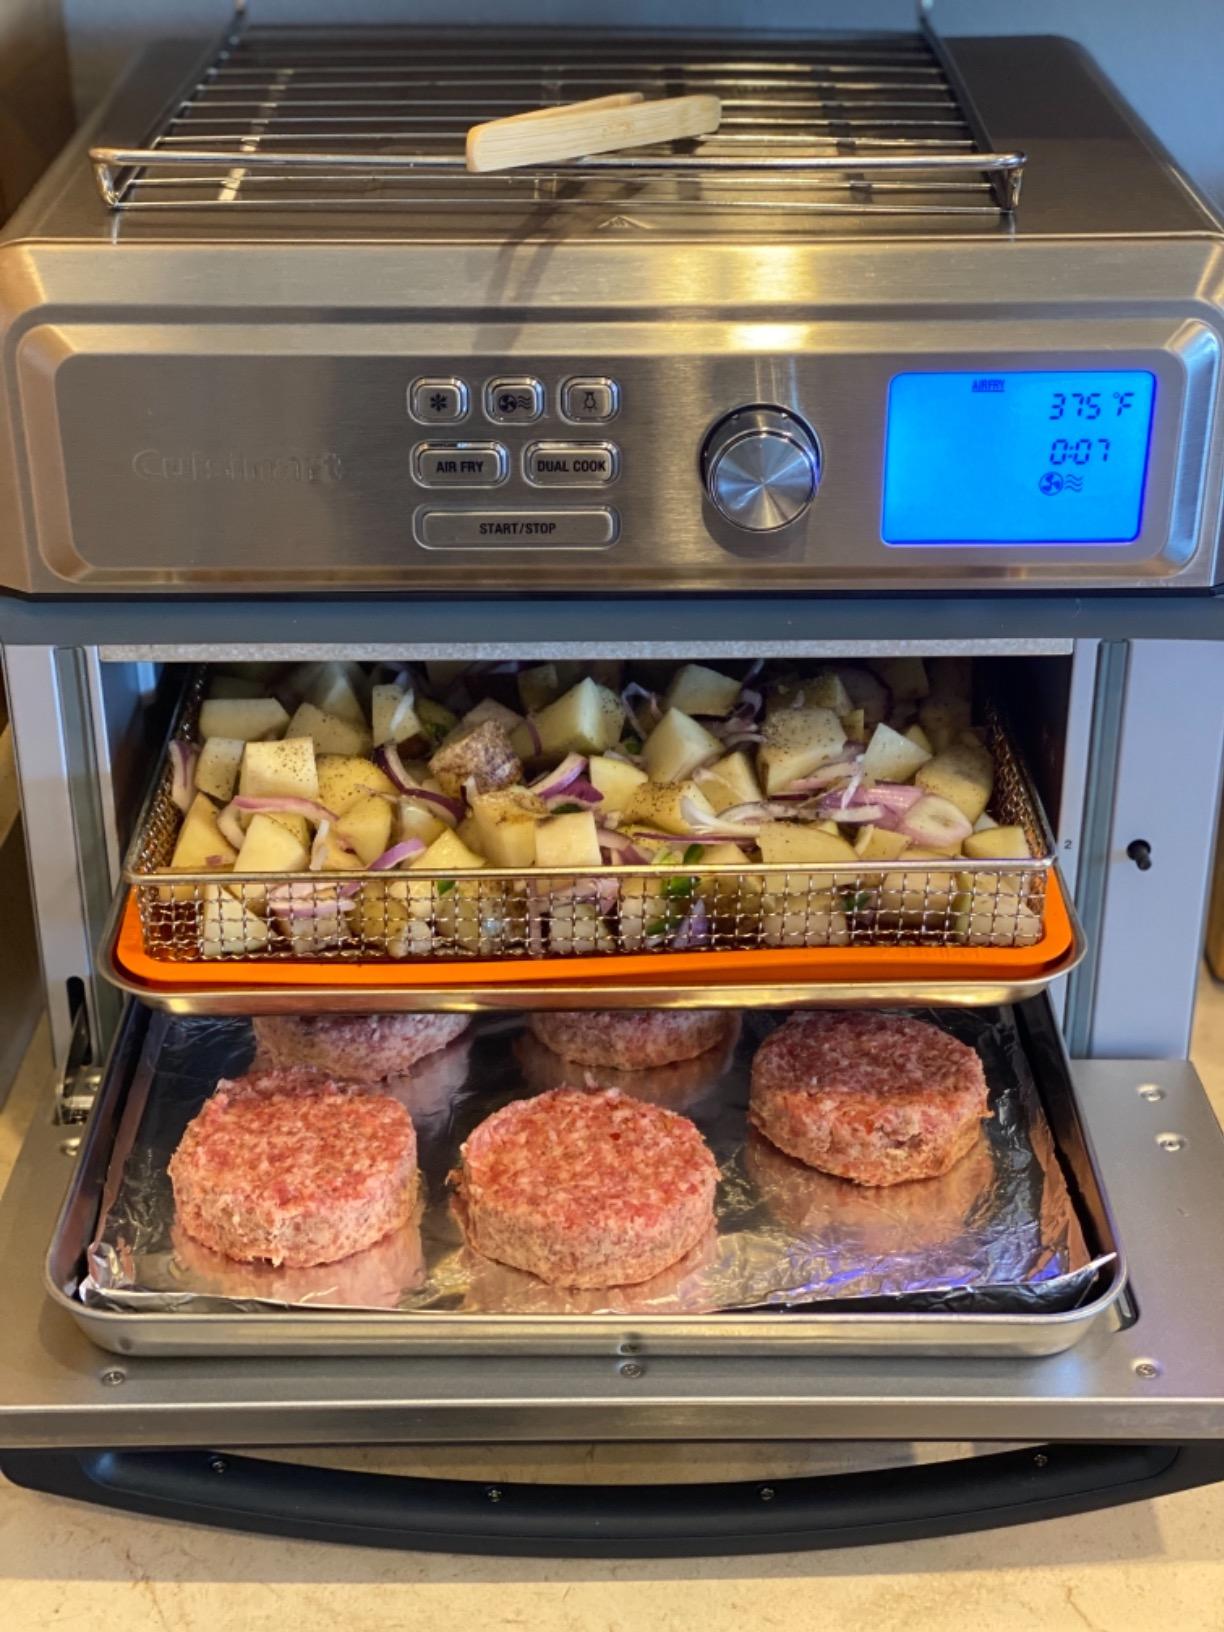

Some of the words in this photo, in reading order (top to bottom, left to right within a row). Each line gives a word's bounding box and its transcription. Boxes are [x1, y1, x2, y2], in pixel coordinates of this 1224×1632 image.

[1049, 393, 1101, 420] 375
[1049, 439, 1110, 465] 0:07
[436, 461, 457, 473] AIR
[461, 461, 484, 472] FRY
[537, 460, 569, 472] DUAL
[573, 460, 606, 472] COOK
[479, 523, 557, 535] START/STOP
[1063, 839, 1072, 850] 2
